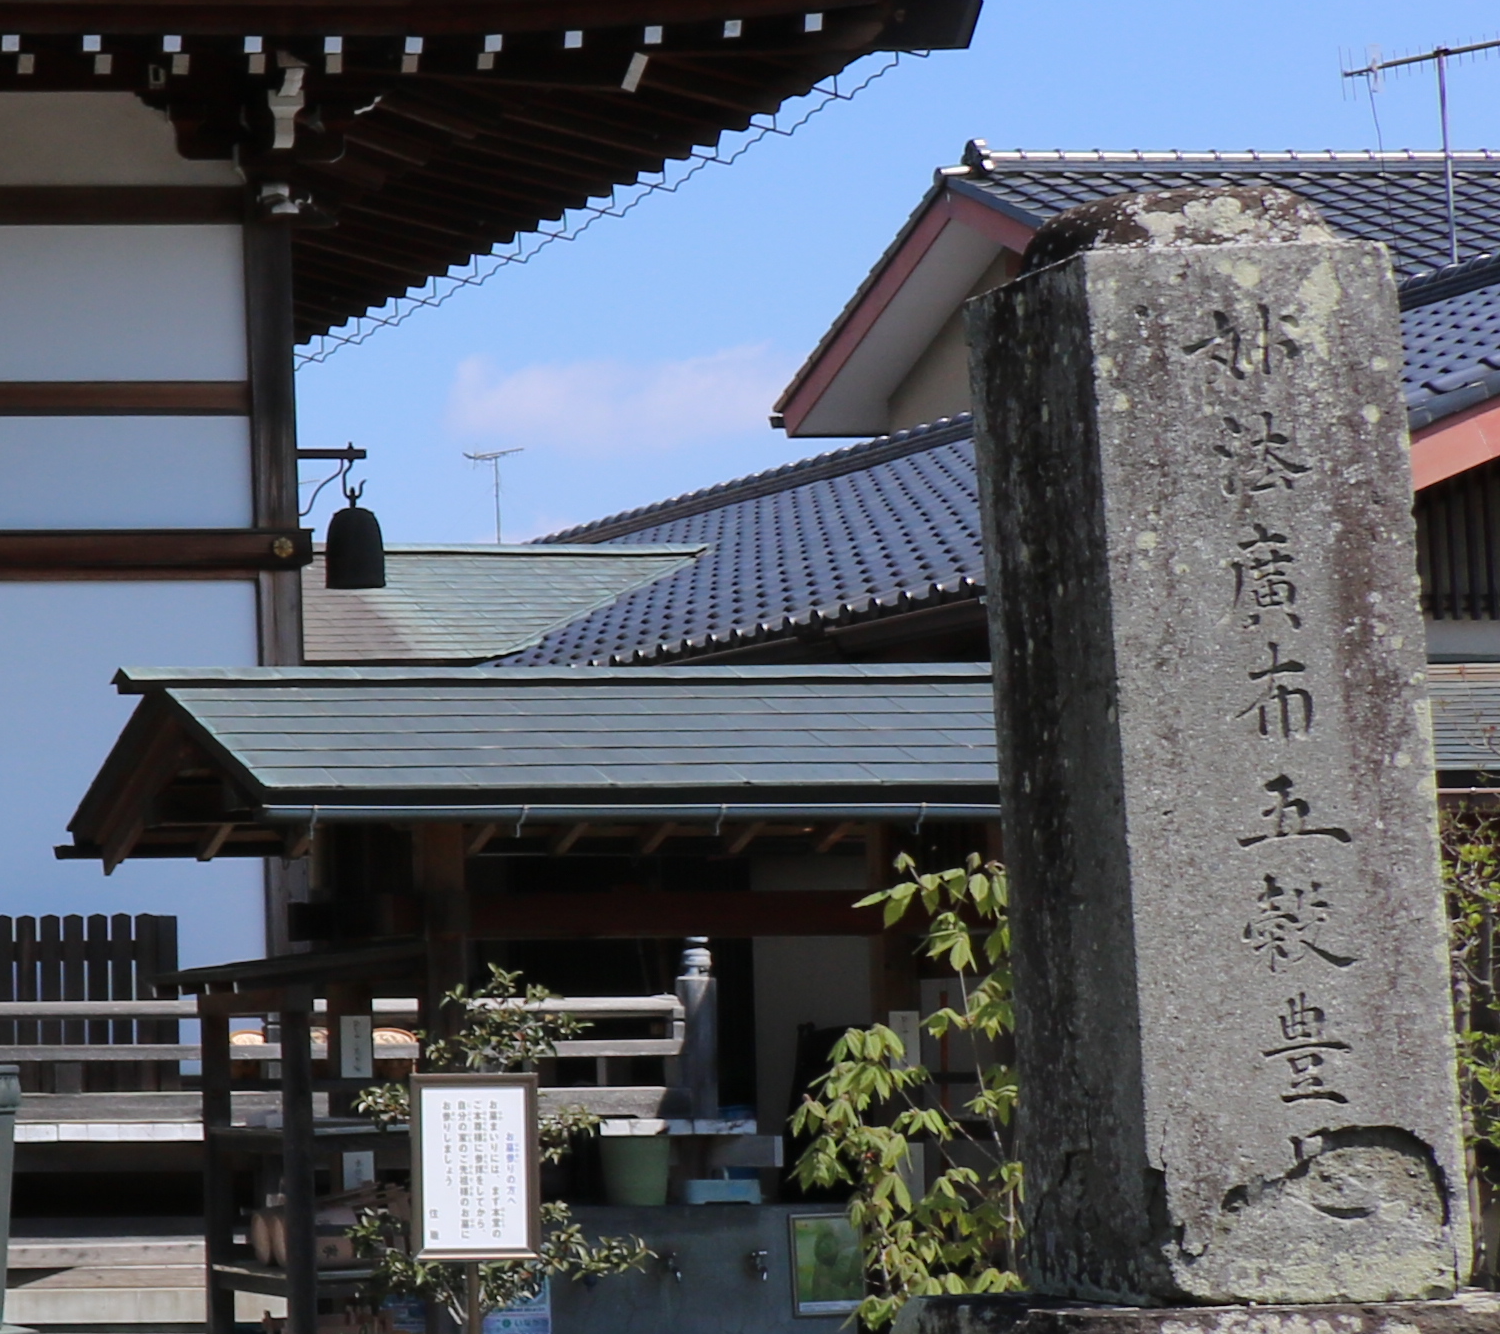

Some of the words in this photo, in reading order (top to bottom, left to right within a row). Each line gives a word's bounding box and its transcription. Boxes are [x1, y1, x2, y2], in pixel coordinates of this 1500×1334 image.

[458, 1100, 470, 1239] 自分の家のご先祖様のお墓に
[473, 1100, 486, 1233] ご本尊様に参拝をしてから、
[489, 1100, 501, 1238] お墓まいりには、まず本堂の
[505, 1132, 517, 1204] お墓参りの方へ
